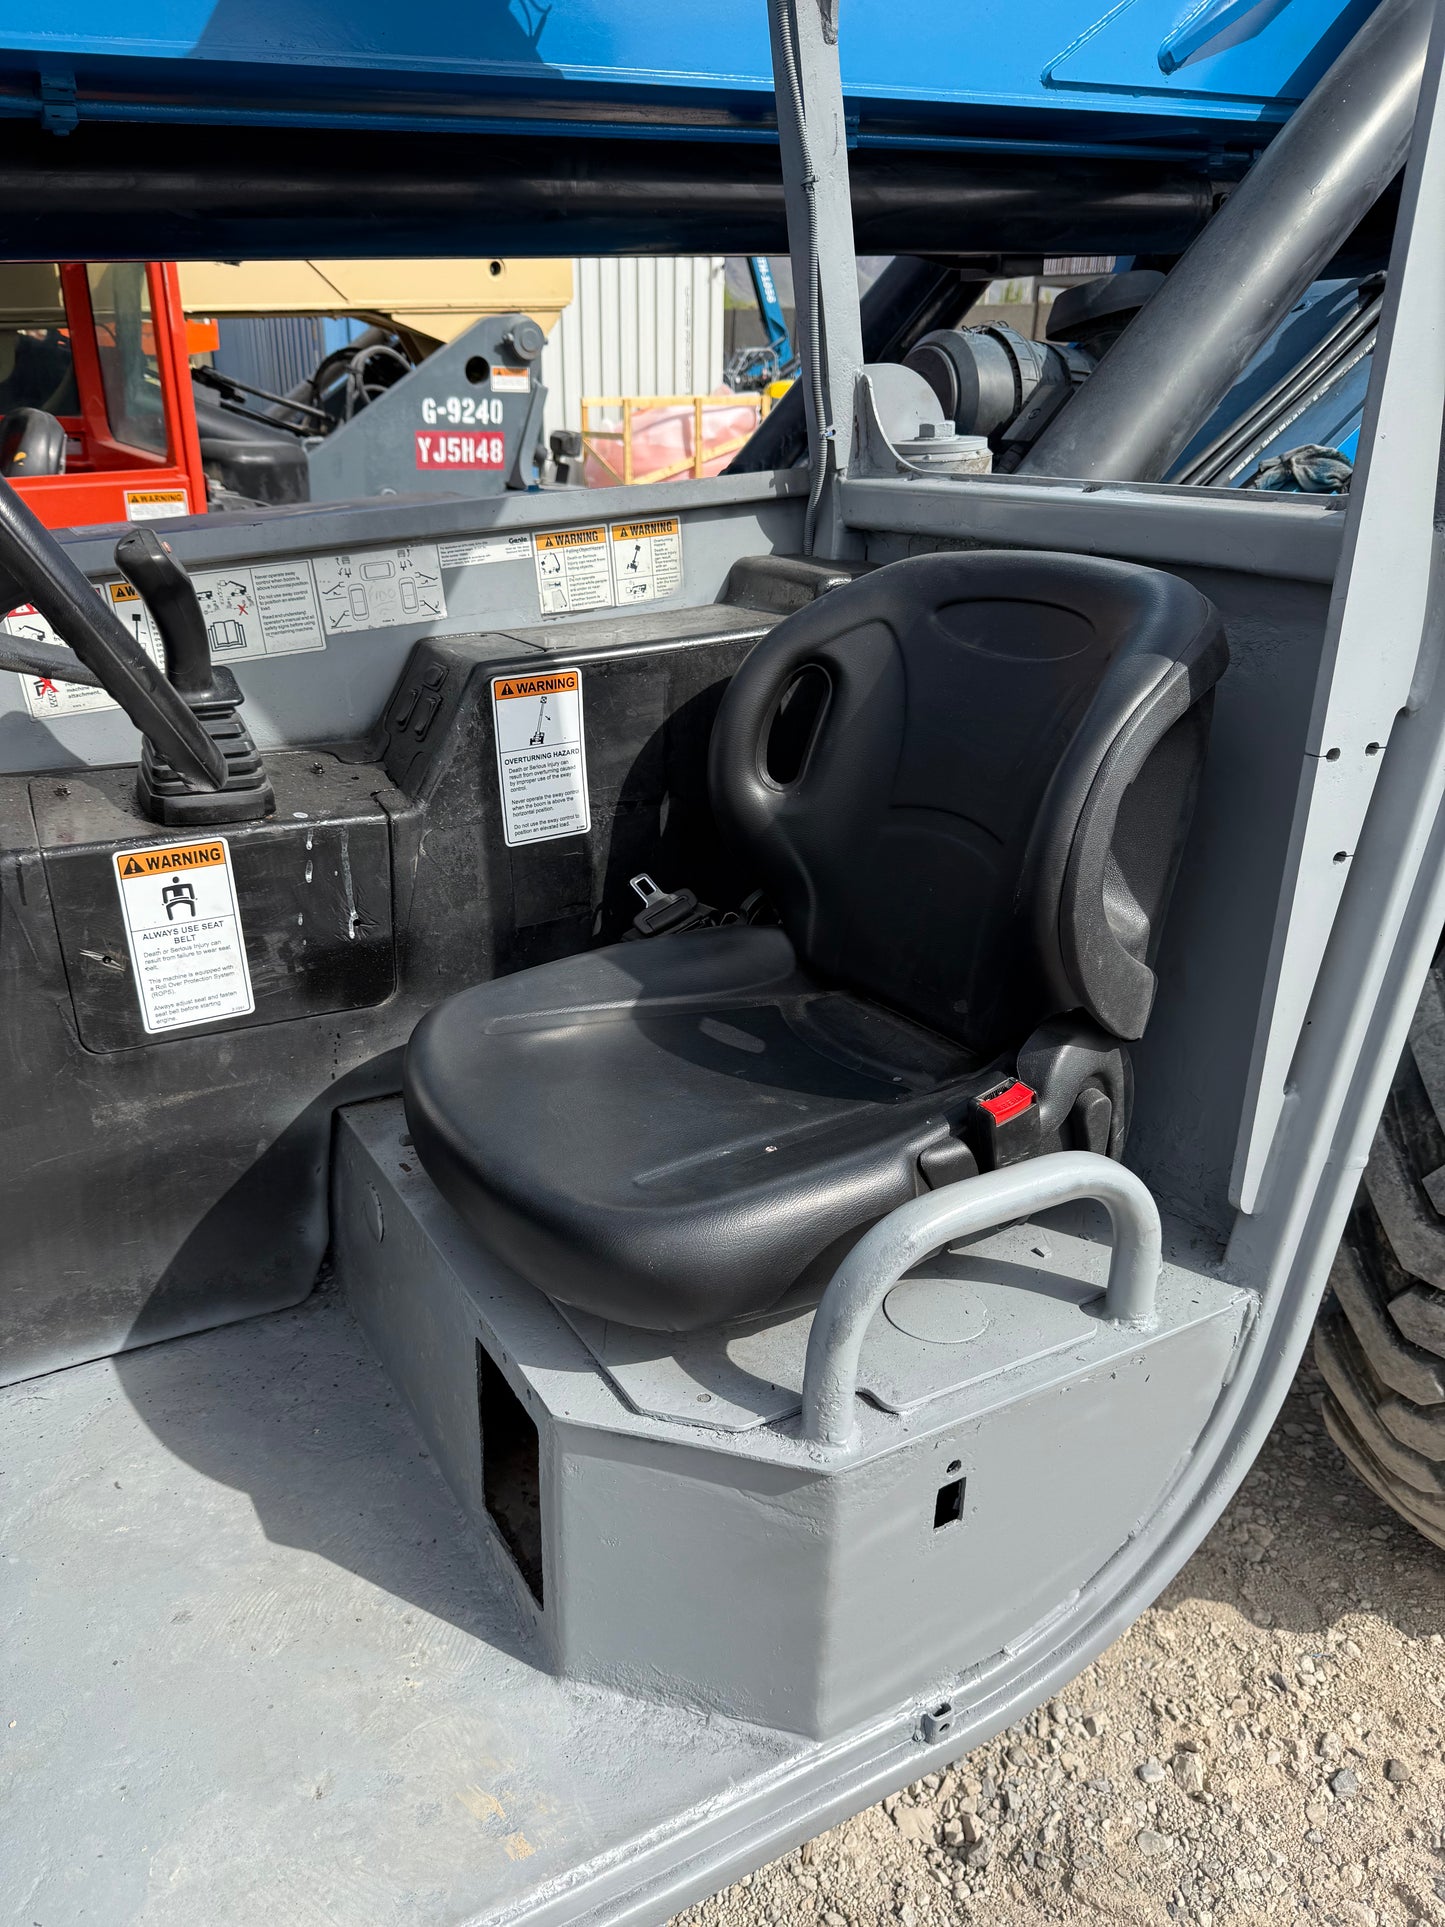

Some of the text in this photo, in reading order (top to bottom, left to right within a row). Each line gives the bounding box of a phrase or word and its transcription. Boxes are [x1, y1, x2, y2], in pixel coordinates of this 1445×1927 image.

[422, 397, 503, 424] G-9240
[417, 436, 503, 464] YJ5H48
[140, 494, 183, 503] WARNING
[630, 522, 672, 536] WARNING
[508, 536, 527, 544] Genie
[555, 531, 598, 546] WARNING
[516, 677, 575, 694] WARNING
[504, 748, 579, 765] OVERTURNING HAZARD
[534, 768, 559, 776] overturning
[510, 785, 527, 793] control.
[516, 778, 536, 786] improper
[513, 806, 554, 817] horizontal position.
[145, 847, 221, 871] WARNING
[142, 920, 224, 941] ALWAYS USE SEAT
[174, 934, 197, 944] BELT
[143, 950, 161, 958] Death
[170, 944, 192, 953] Serious
[193, 941, 210, 950] Injury
[145, 957, 161, 965] result
[177, 951, 195, 959] failure
[163, 973, 187, 982] machine
[195, 967, 221, 977] equipped
[168, 980, 183, 988] Over
[183, 975, 212, 985] Protection
[214, 970, 235, 980] System
[151, 988, 175, 999] (ROPS).
[153, 1002, 174, 1012] Always
[176, 999, 193, 1007] adjust
[220, 990, 237, 999] fasten
[200, 1000, 222, 1009] starting
[156, 1016, 177, 1025] engine.
